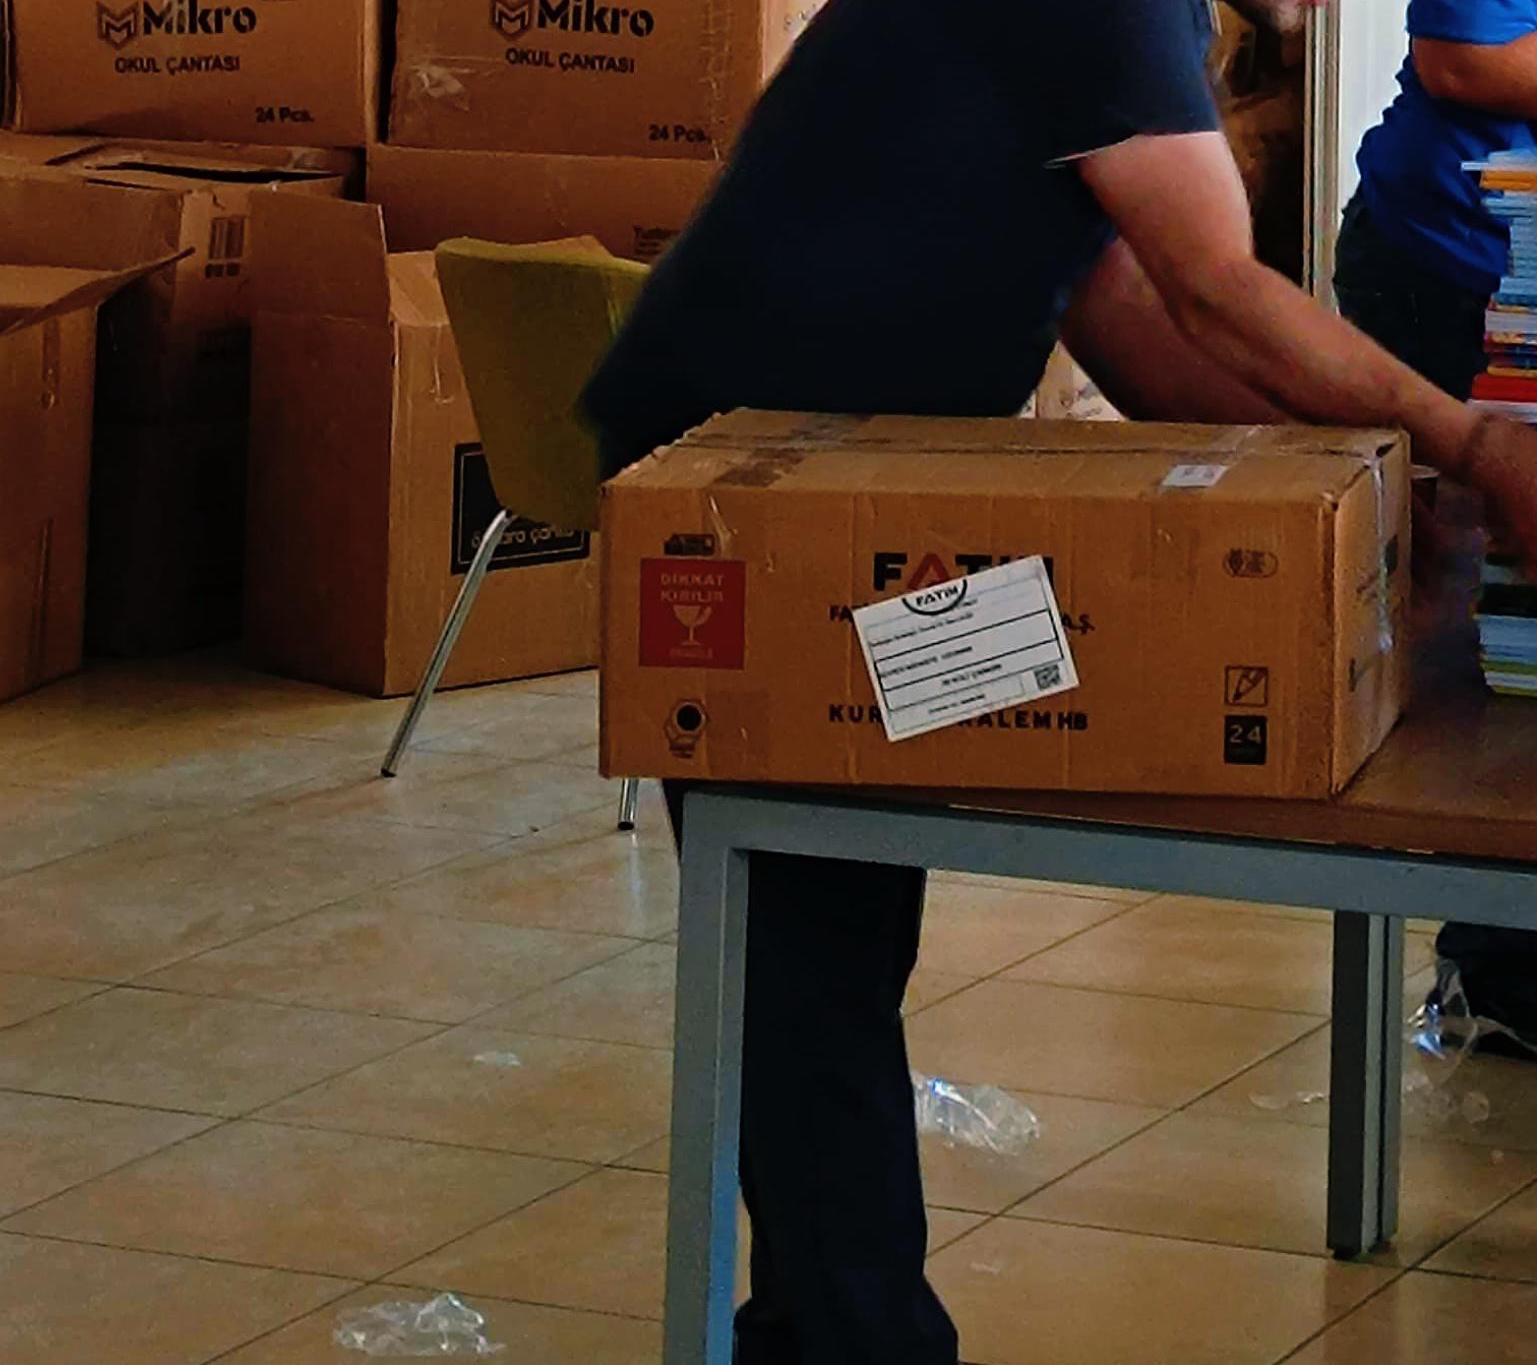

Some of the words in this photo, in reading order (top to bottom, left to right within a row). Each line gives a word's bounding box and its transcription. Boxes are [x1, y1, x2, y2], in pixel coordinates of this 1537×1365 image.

[114, 57, 161, 74] OKUL
[167, 55, 240, 75] ÇANTASI
[505, 47, 555, 68] OKUL
[559, 52, 635, 73] ÇANTASI
[255, 107, 275, 123] 24
[648, 124, 669, 142] 24
[1058, 711, 1088, 731] HB
[1229, 724, 1262, 744] 24
